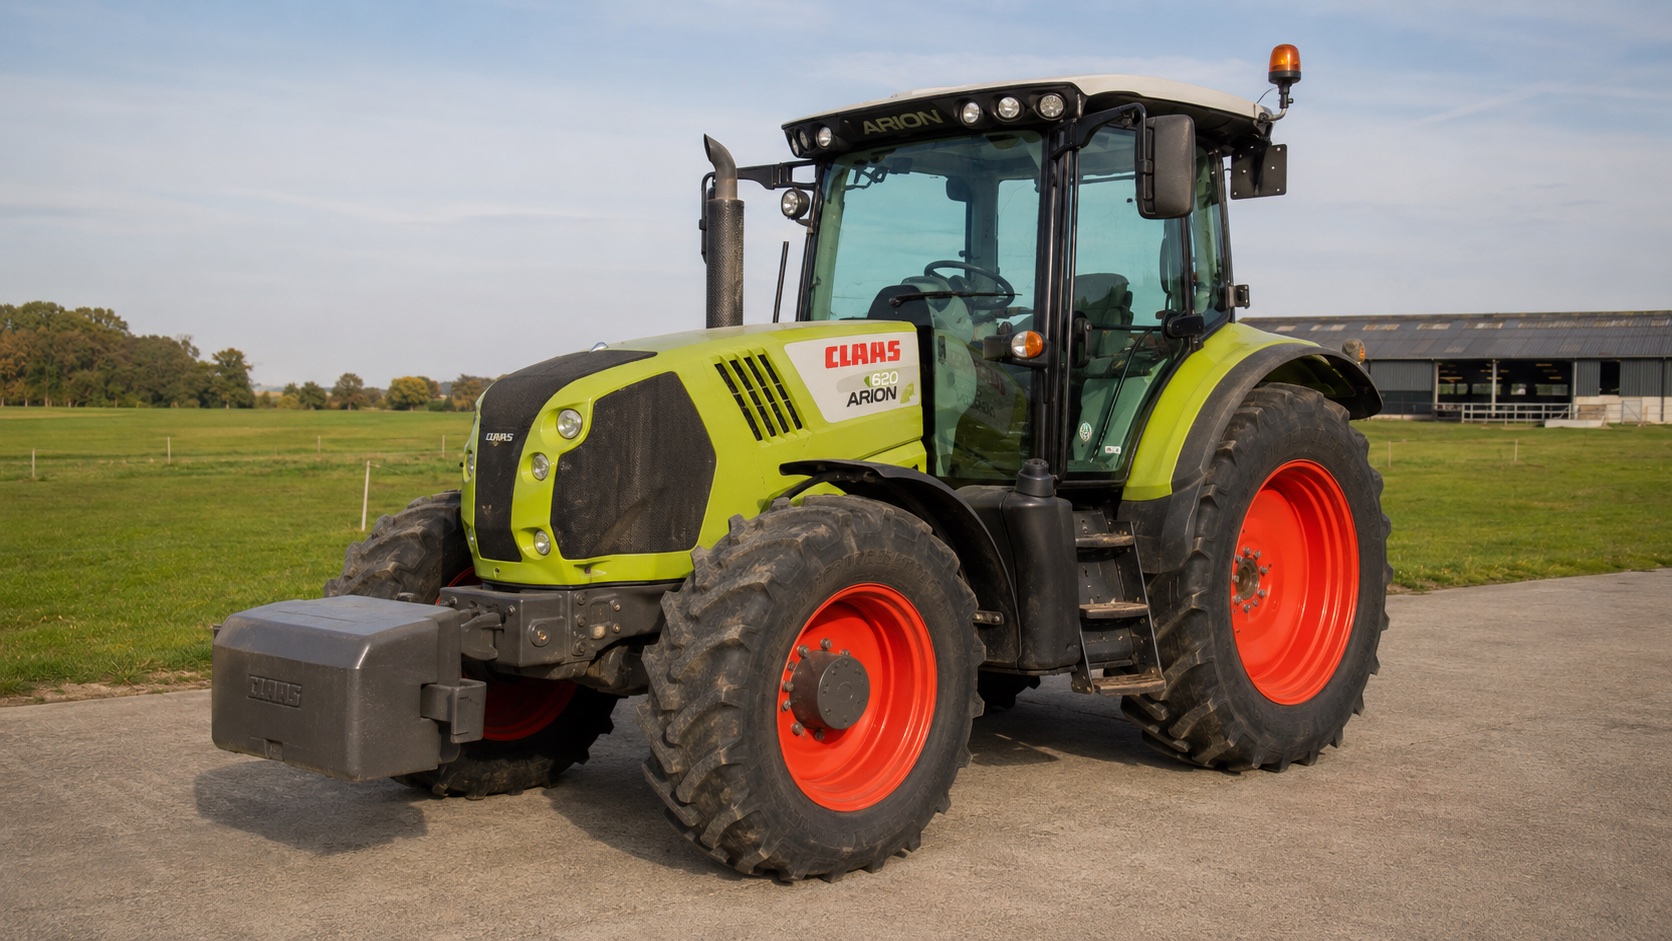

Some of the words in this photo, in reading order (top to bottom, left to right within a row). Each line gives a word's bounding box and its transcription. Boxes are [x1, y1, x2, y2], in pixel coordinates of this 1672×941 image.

[863, 109, 944, 135] ARION
[825, 340, 901, 369] CLAAS
[871, 371, 899, 387] 620
[846, 386, 897, 408] ARION
